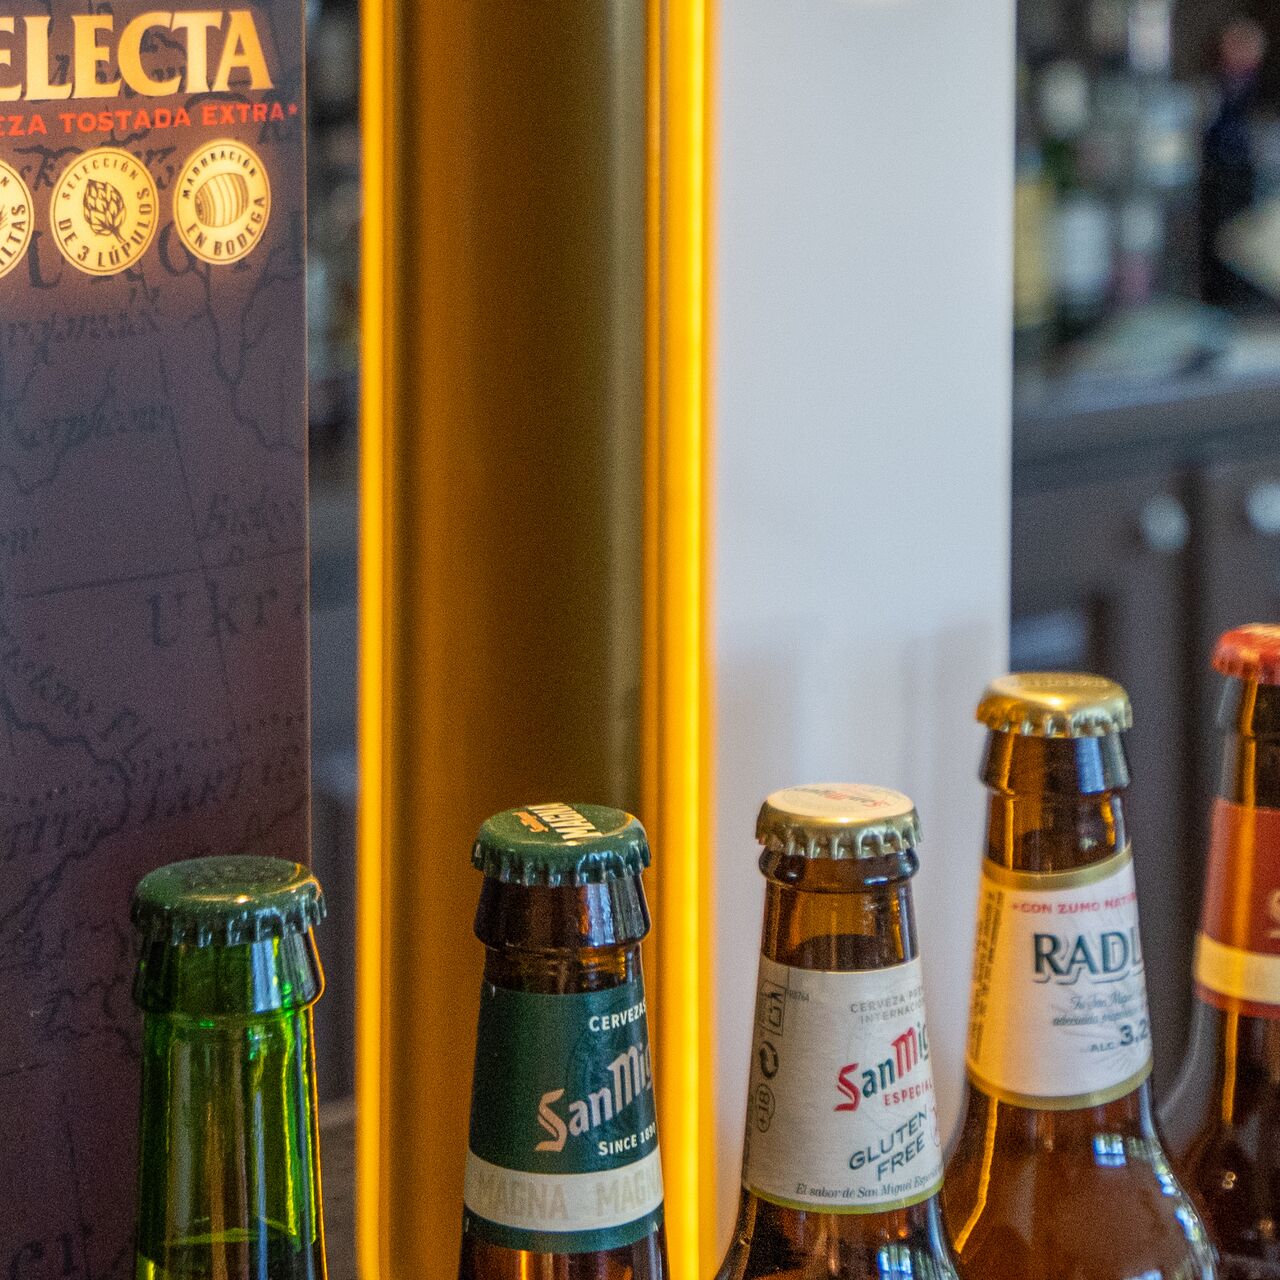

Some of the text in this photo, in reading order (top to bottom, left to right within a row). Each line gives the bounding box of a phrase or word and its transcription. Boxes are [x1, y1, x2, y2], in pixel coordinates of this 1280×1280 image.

[60, 107, 191, 133] TOSTADA
[202, 103, 284, 126] EXTRA
[62, 158, 139, 200] SELECCIÓN
[182, 150, 256, 199] MADURACIÓN
[58, 187, 152, 267] DE 3 LÚPULOS
[186, 197, 265, 256] EN BODEGA
[851, 995, 906, 1013] CERVEZA
[834, 1058, 896, 1111] San
[535, 1087, 613, 1152] San
[849, 1104, 927, 1170] GLUTEN
[598, 1134, 638, 1156] SINCE
[877, 1131, 925, 1181] FREE
[477, 1171, 569, 1220] MAGNA
[795, 1183, 806, 1195] El
[810, 1187, 840, 1199] sabor
